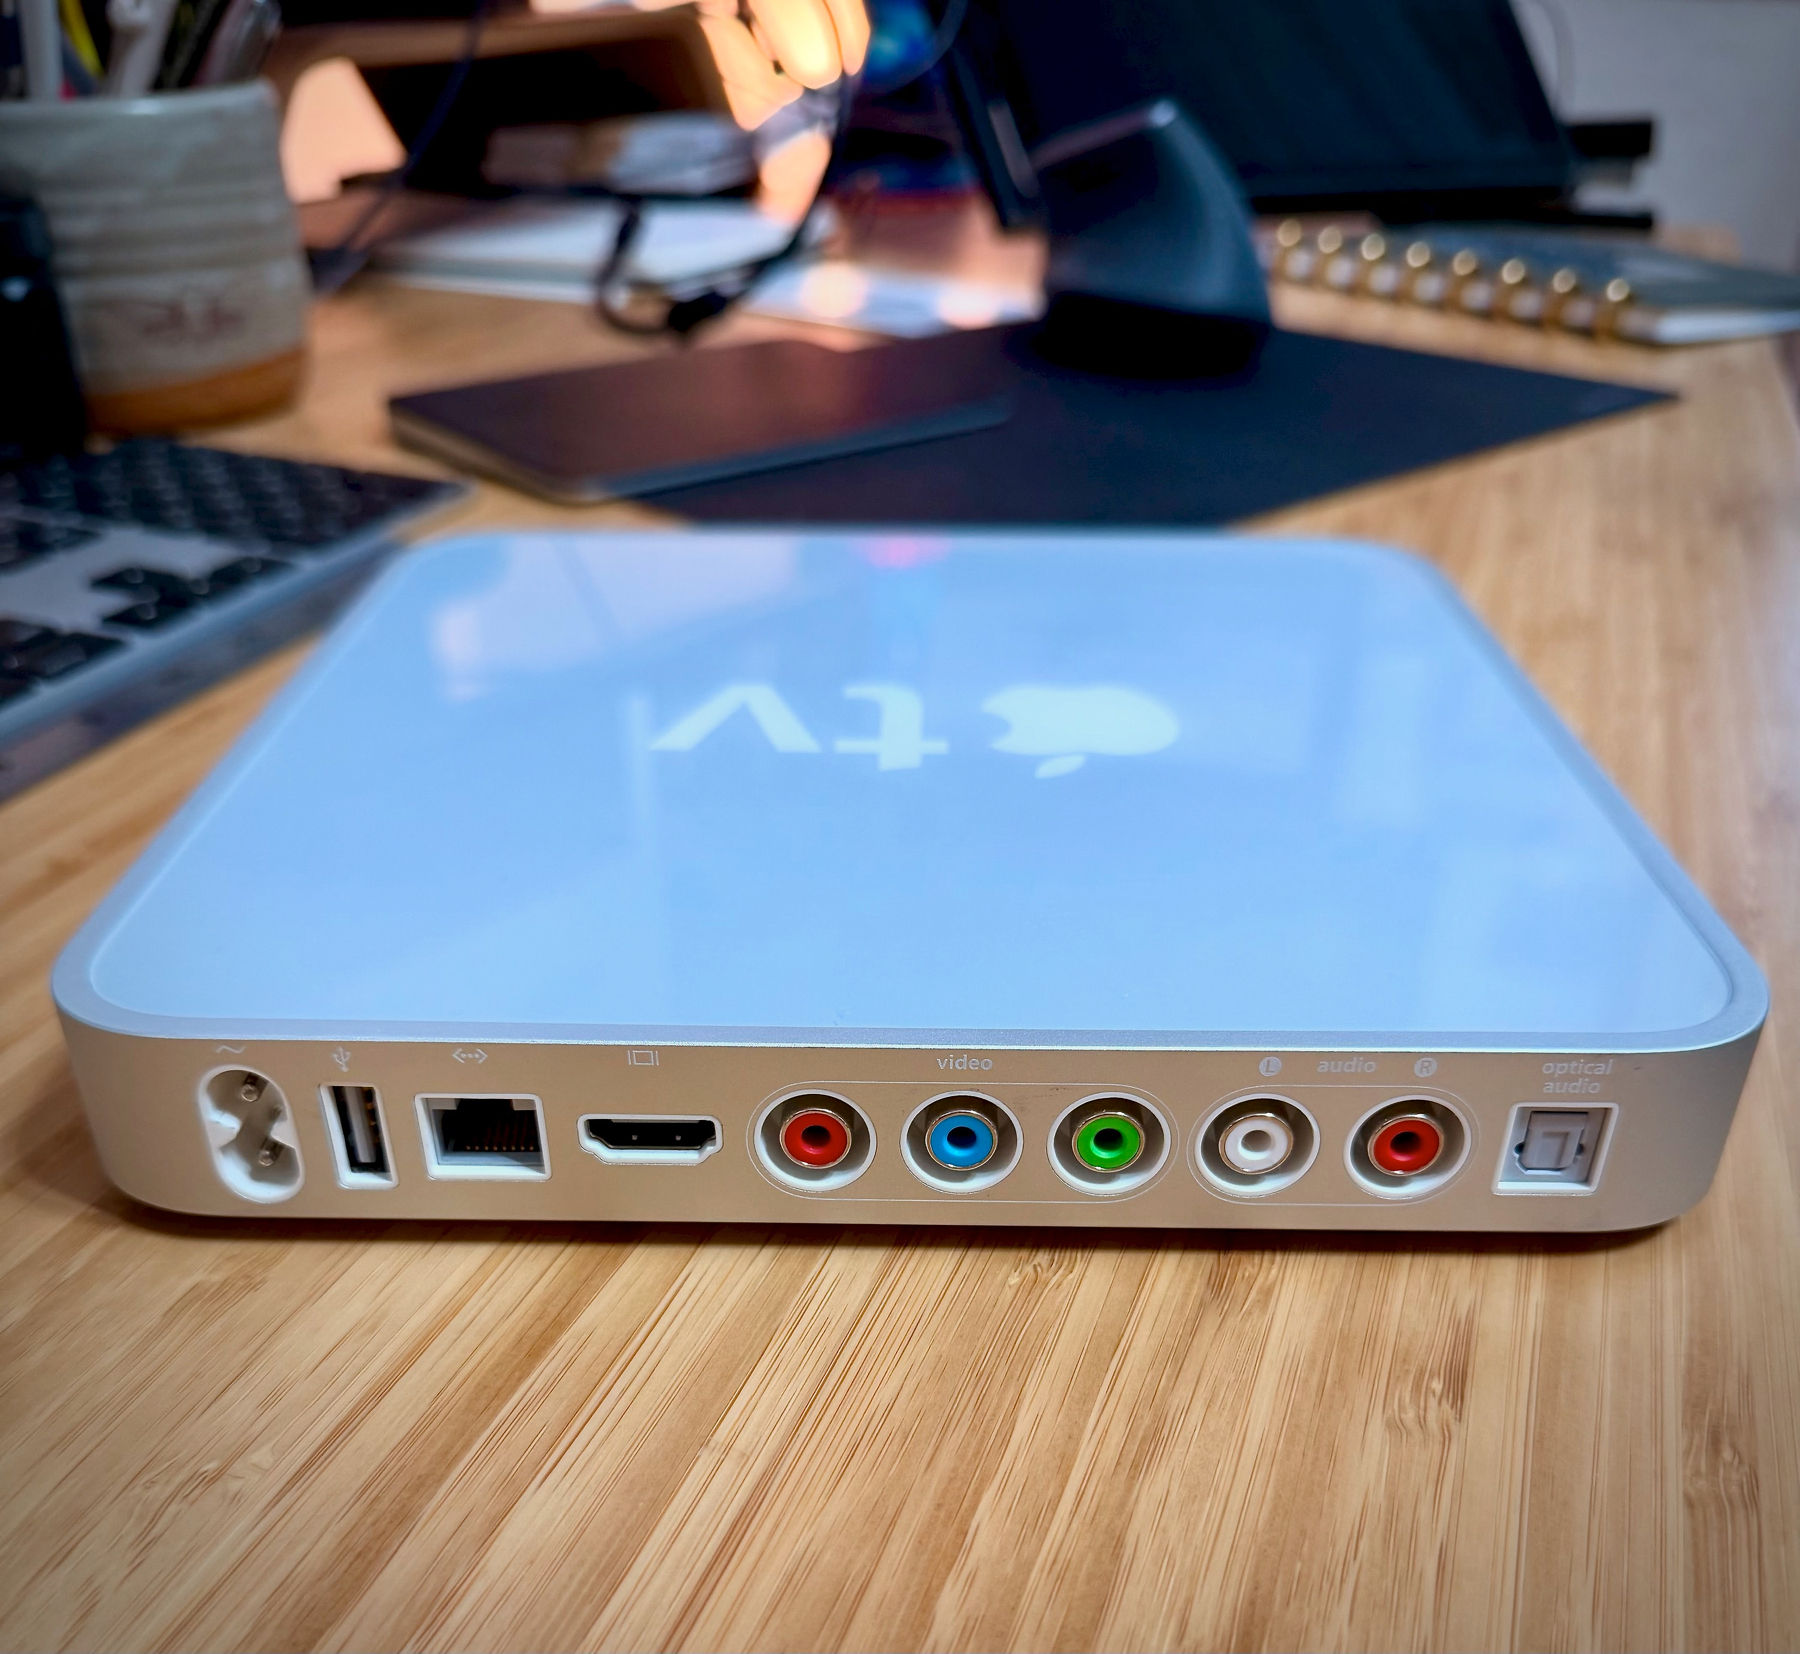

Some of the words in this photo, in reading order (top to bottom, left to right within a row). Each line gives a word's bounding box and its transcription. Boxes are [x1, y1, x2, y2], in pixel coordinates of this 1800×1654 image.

[648, 684, 949, 771] tv
[936, 1054, 994, 1071] video
[1316, 1056, 1378, 1074] audio
[1541, 1058, 1614, 1078] optical
[1543, 1078, 1602, 1094] audio
